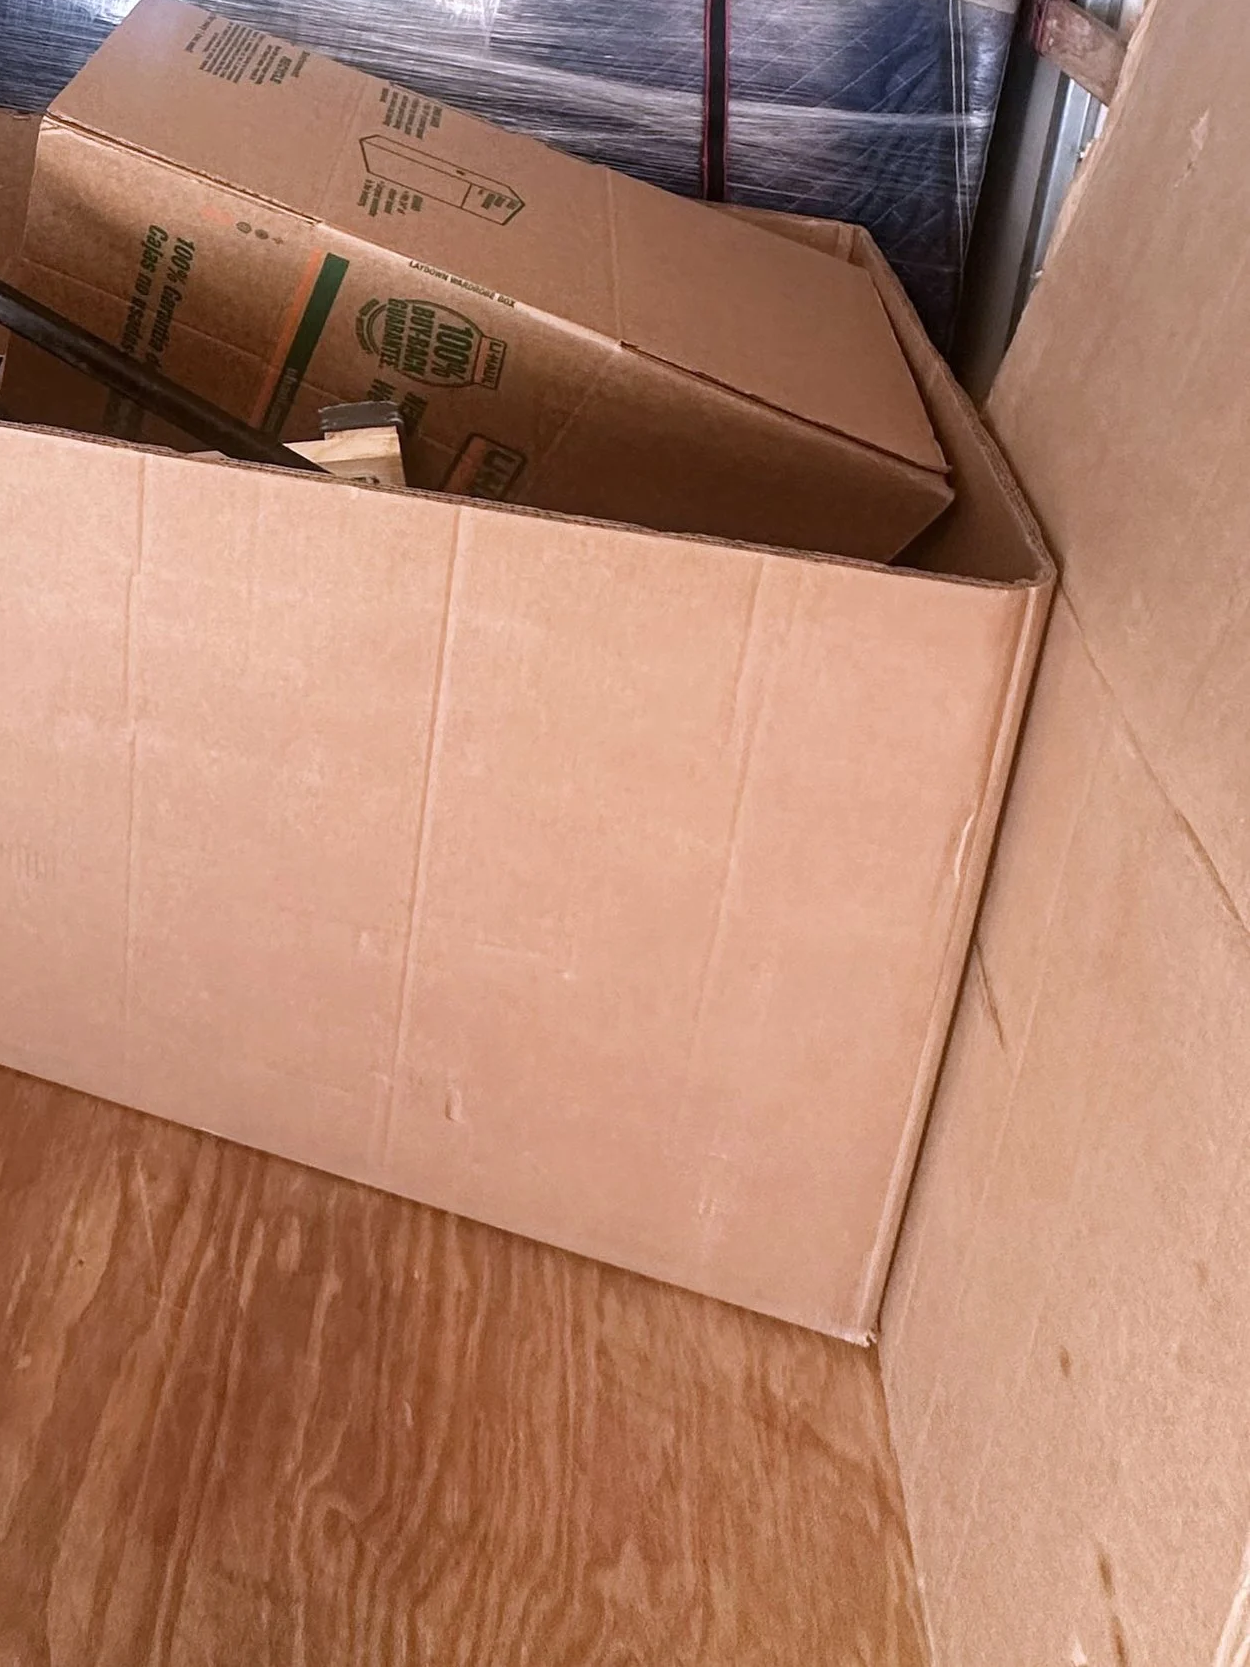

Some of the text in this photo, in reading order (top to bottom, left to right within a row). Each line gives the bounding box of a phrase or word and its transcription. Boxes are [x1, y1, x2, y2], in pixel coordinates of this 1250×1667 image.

[141, 225, 168, 273] Cajas
[166, 237, 195, 285] 100%
[134, 272, 152, 296] no
[409, 260, 516, 309] LAYDOWN WARDROBE BOX
[401, 305, 436, 376] BUY-BACK
[430, 323, 474, 380] 100%
[482, 341, 502, 384] U-HAUL
